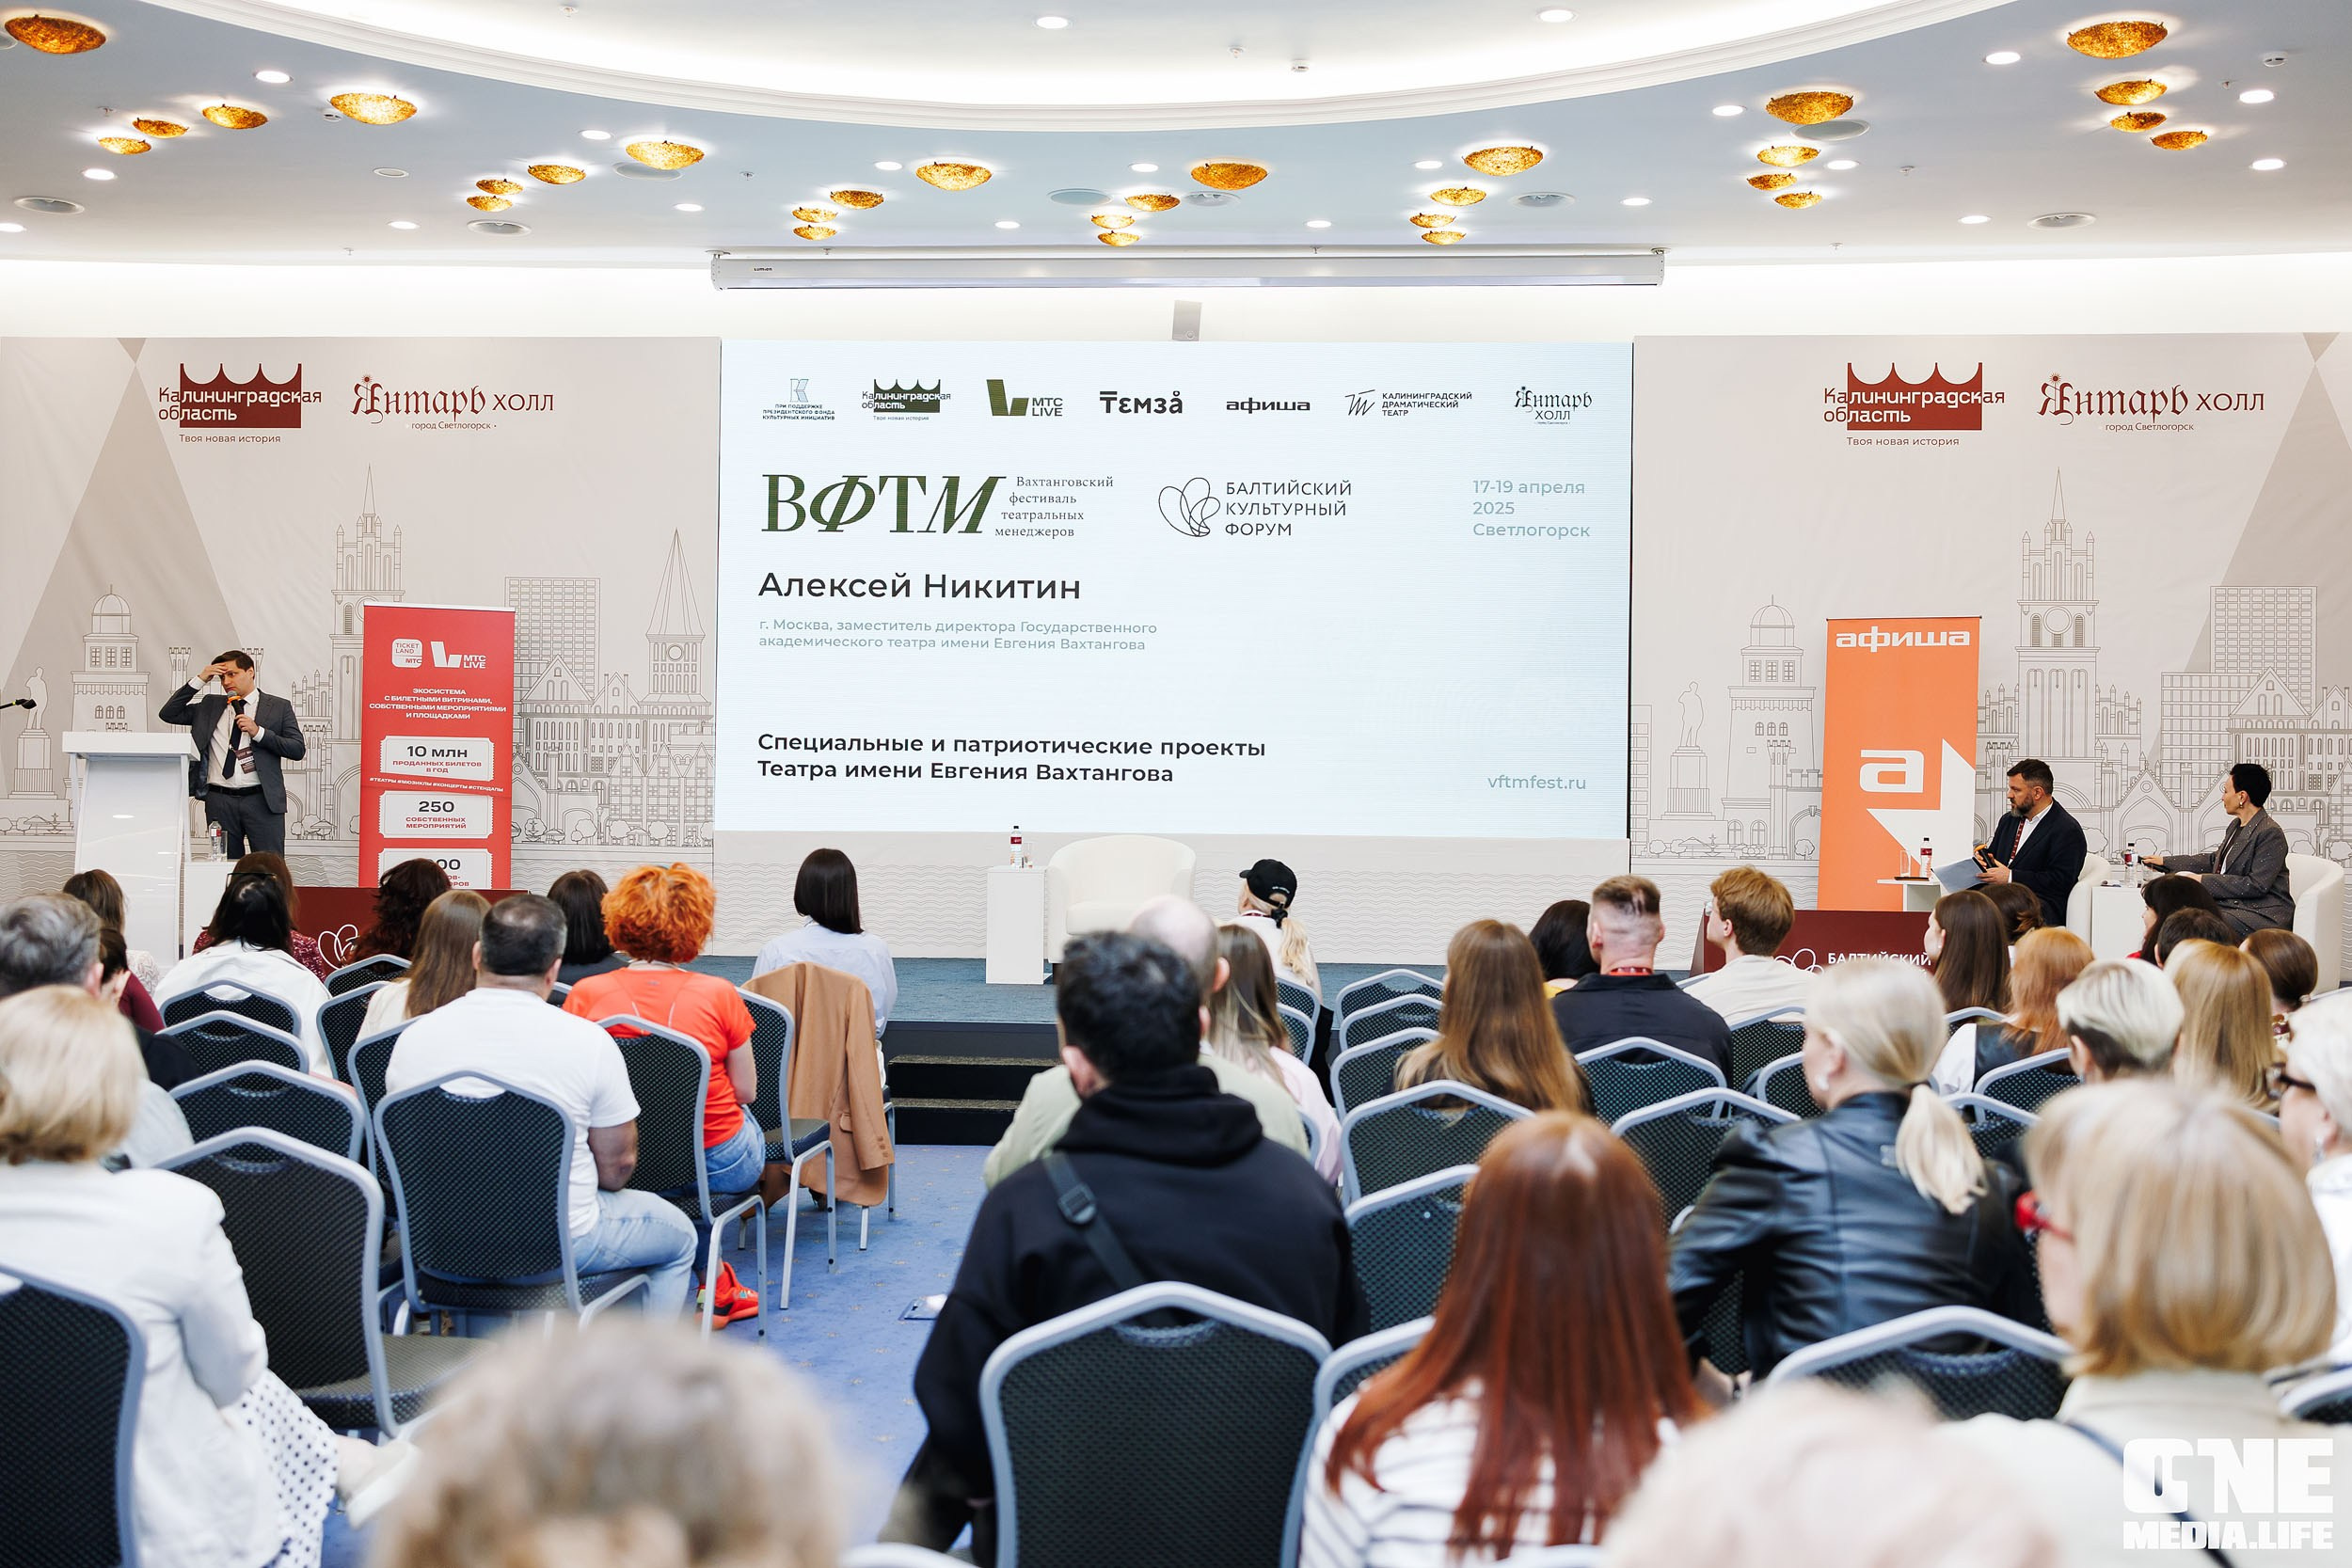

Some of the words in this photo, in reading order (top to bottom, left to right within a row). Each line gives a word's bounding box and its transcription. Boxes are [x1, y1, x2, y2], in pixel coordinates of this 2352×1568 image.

[158, 388, 322, 408] Калининградская
[350, 382, 486, 424] Янтарь
[862, 390, 951, 403] Калининградская
[1032, 397, 1063, 407] МТС
[1382, 391, 1472, 401] КАЛИНИНГРАДСКИЙ
[1514, 388, 1593, 413] Янтарь
[1823, 388, 2006, 411] Калининградская
[862, 401, 906, 409] область
[1226, 397, 1311, 415] афиша
[1382, 400, 1459, 409] ДРАМАТИЧЕСКИЙ
[2036, 382, 2189, 426] Янтарь
[158, 405, 238, 420] область
[1032, 408, 1063, 417] LIVE
[1823, 406, 1912, 423] область
[411, 422, 437, 431] город
[438, 420, 491, 431] Светлогорск
[2106, 423, 2134, 432] город
[2136, 421, 2194, 432] Светлогорск
[179, 434, 202, 443] Твоя
[205, 435, 236, 444] новая
[238, 435, 281, 445] история
[1847, 436, 1872, 446] Твоя
[1876, 436, 1910, 447] новая
[1912, 437, 1961, 448] история
[1016, 475, 1114, 487] Вахтанговский
[1226, 480, 1353, 497] БАЛТИЙСКИЙ
[1473, 480, 1514, 495] 17-19
[1518, 483, 1586, 498] апреля
[761, 474, 1007, 533] ВФТМ
[1009, 492, 1077, 507] фестиваль
[1226, 500, 1347, 517] КУЛЬТУРНЫЙ
[1473, 500, 1515, 515] 2025
[1001, 510, 1085, 523] театральных
[994, 527, 1074, 540] менеджеров
[1225, 522, 1293, 537] ФОРУМ
[1473, 523, 1592, 540] Светлогорск
[758, 572, 911, 598] Алексей
[925, 574, 1081, 600] Никитин
[759, 622, 769, 630] г.
[773, 620, 834, 633] Москва,
[836, 621, 931, 632] заместитель
[935, 623, 1016, 636] директора
[1020, 621, 1157, 637] Государственного
[759, 638, 883, 649] академического
[887, 640, 936, 651] театра
[941, 640, 990, 649] имени
[993, 638, 1056, 649] Евгения
[1061, 639, 1146, 650] Вахтангова
[1836, 626, 1970, 653] афиша
[406, 745, 427, 757] 10
[758, 733, 924, 754] Специальные
[931, 737, 945, 752] и
[953, 737, 1153, 758] патриотические
[1161, 740, 1266, 760] проекты
[757, 760, 837, 782] Театра
[845, 764, 922, 779] имени
[931, 762, 1027, 781] Евгения
[1036, 764, 1174, 783] Вахтангова
[1487, 775, 1586, 790] vftmfest.ru
[418, 801, 455, 813] 250
